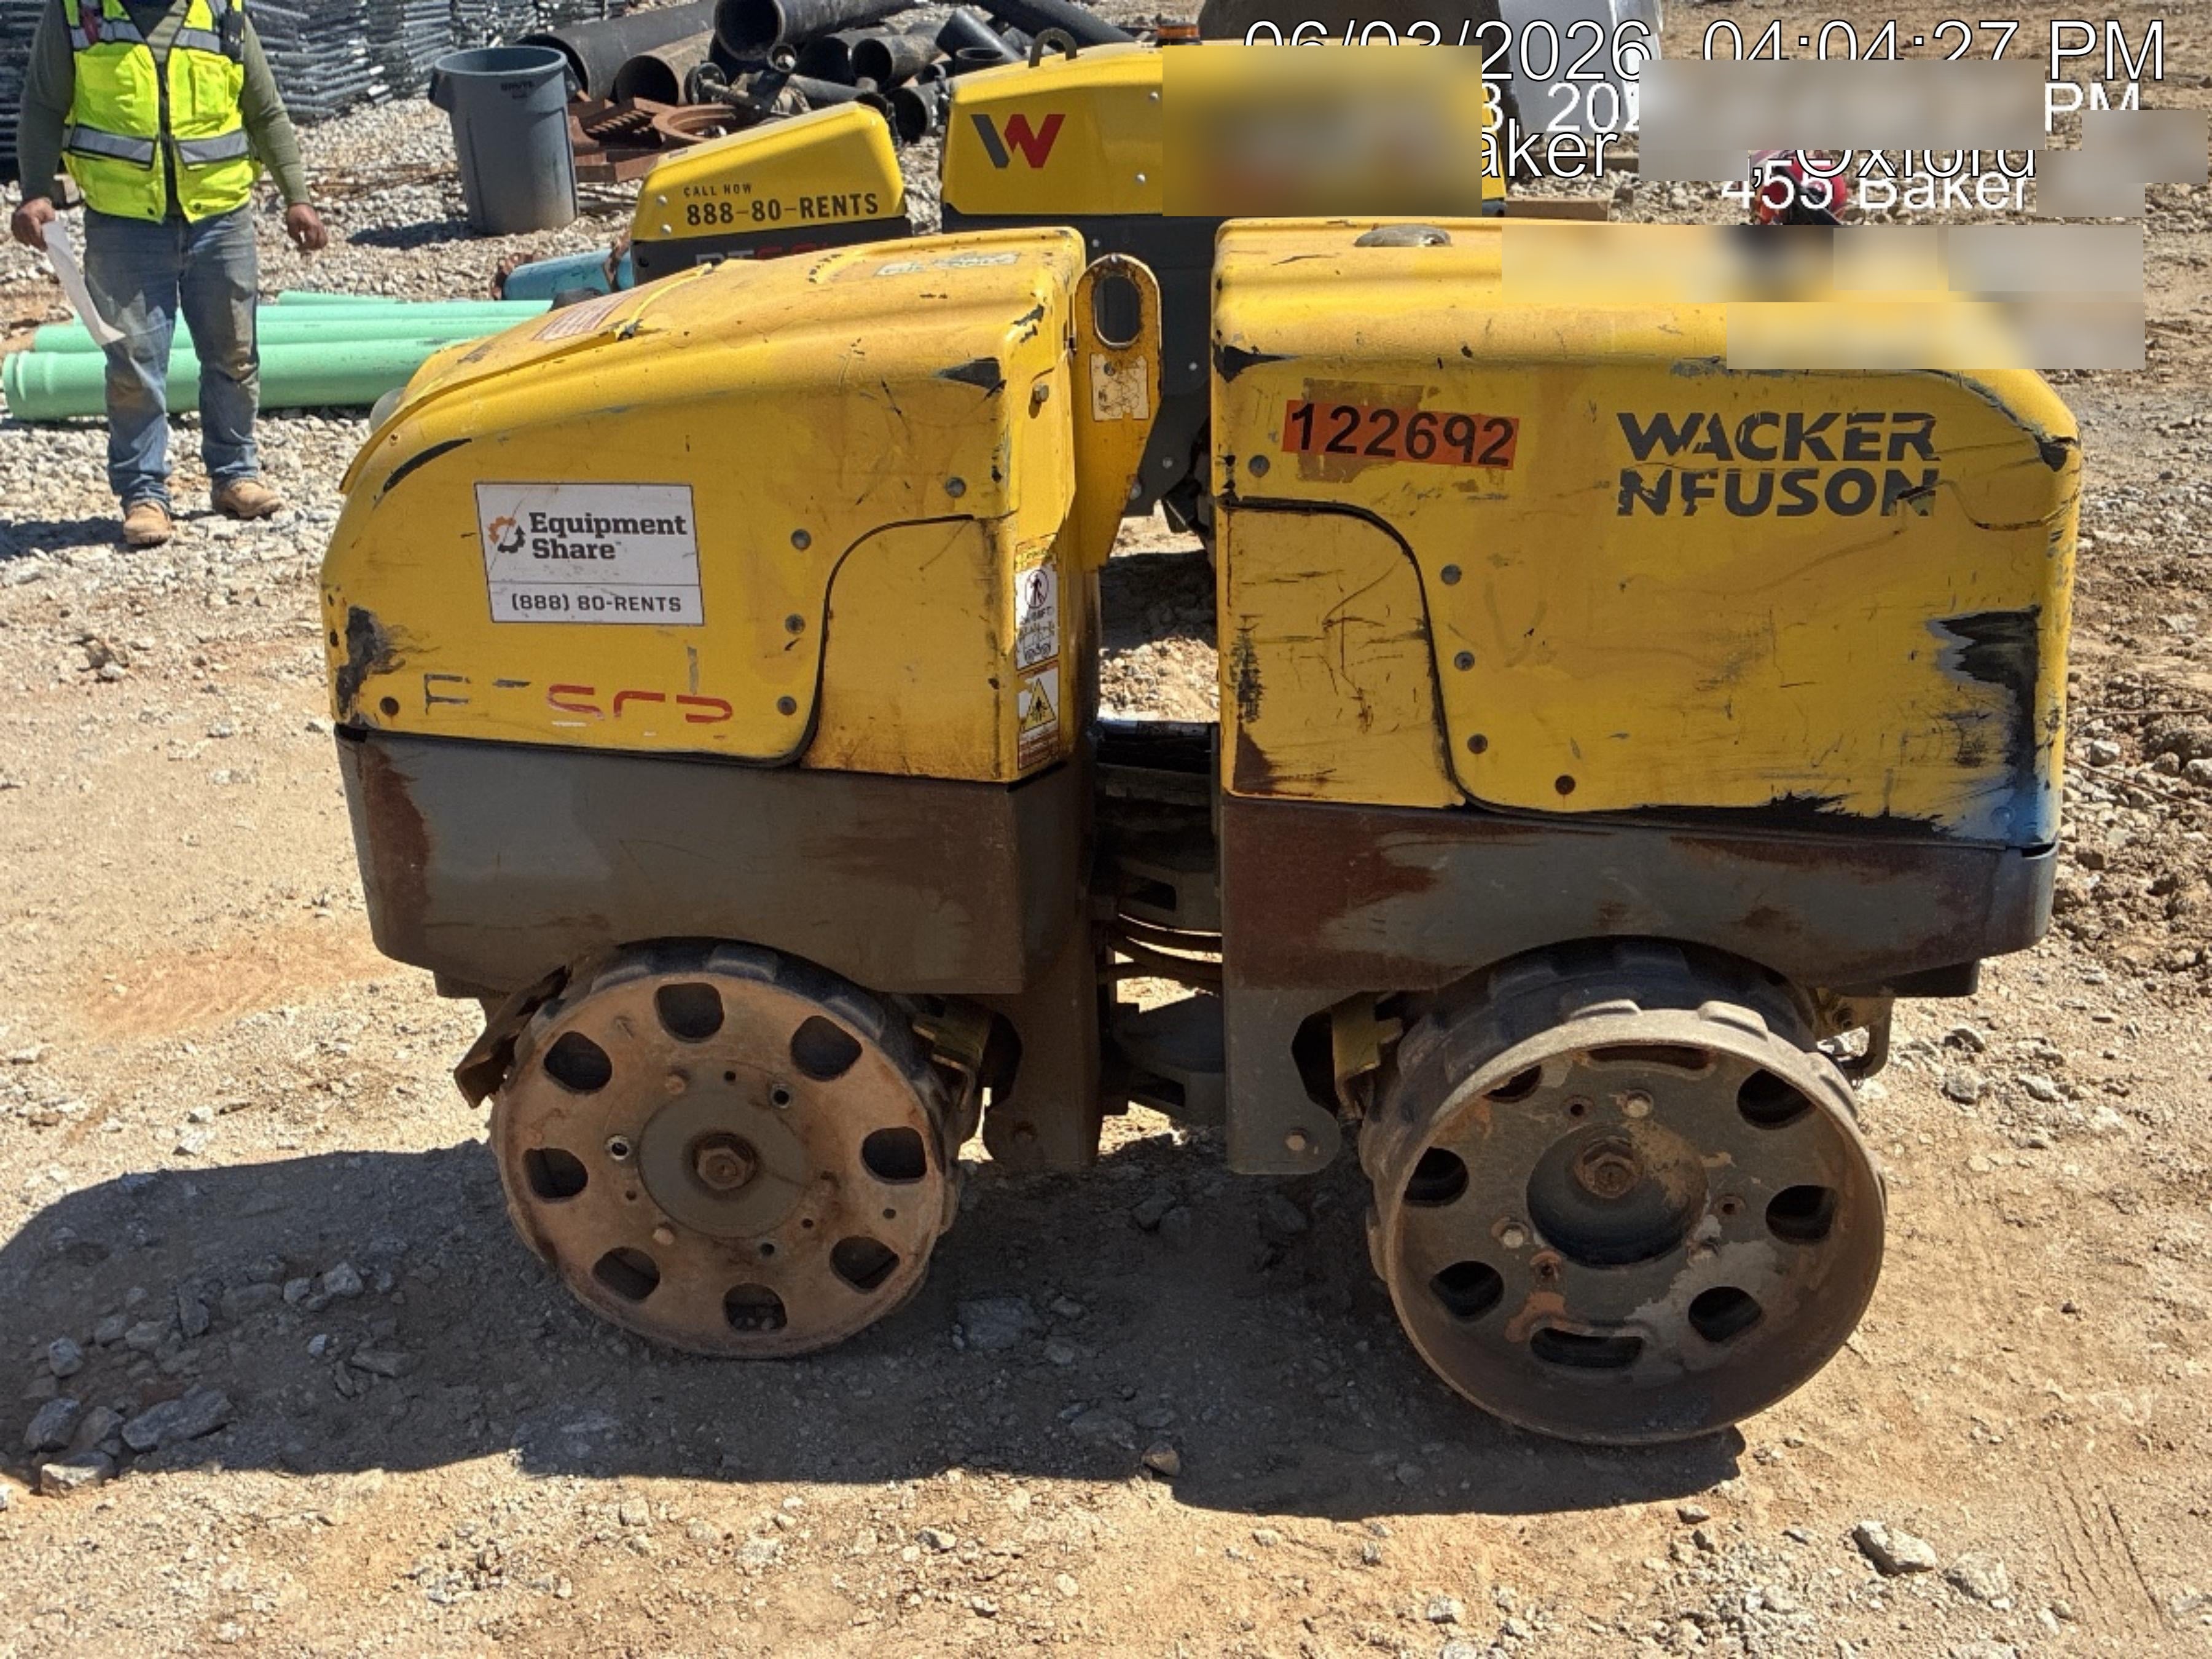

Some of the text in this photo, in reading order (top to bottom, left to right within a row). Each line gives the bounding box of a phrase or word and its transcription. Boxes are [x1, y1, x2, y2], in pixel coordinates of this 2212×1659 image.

[683, 184, 752, 197] CALL NOW
[686, 192, 879, 226] 888-80-RENTS
[1291, 402, 1515, 467] 122692
[1616, 412, 1942, 461] WACKER
[528, 512, 688, 539] Equipment
[531, 538, 617, 560] Share
[511, 593, 682, 613] (888) 80-RENTS
